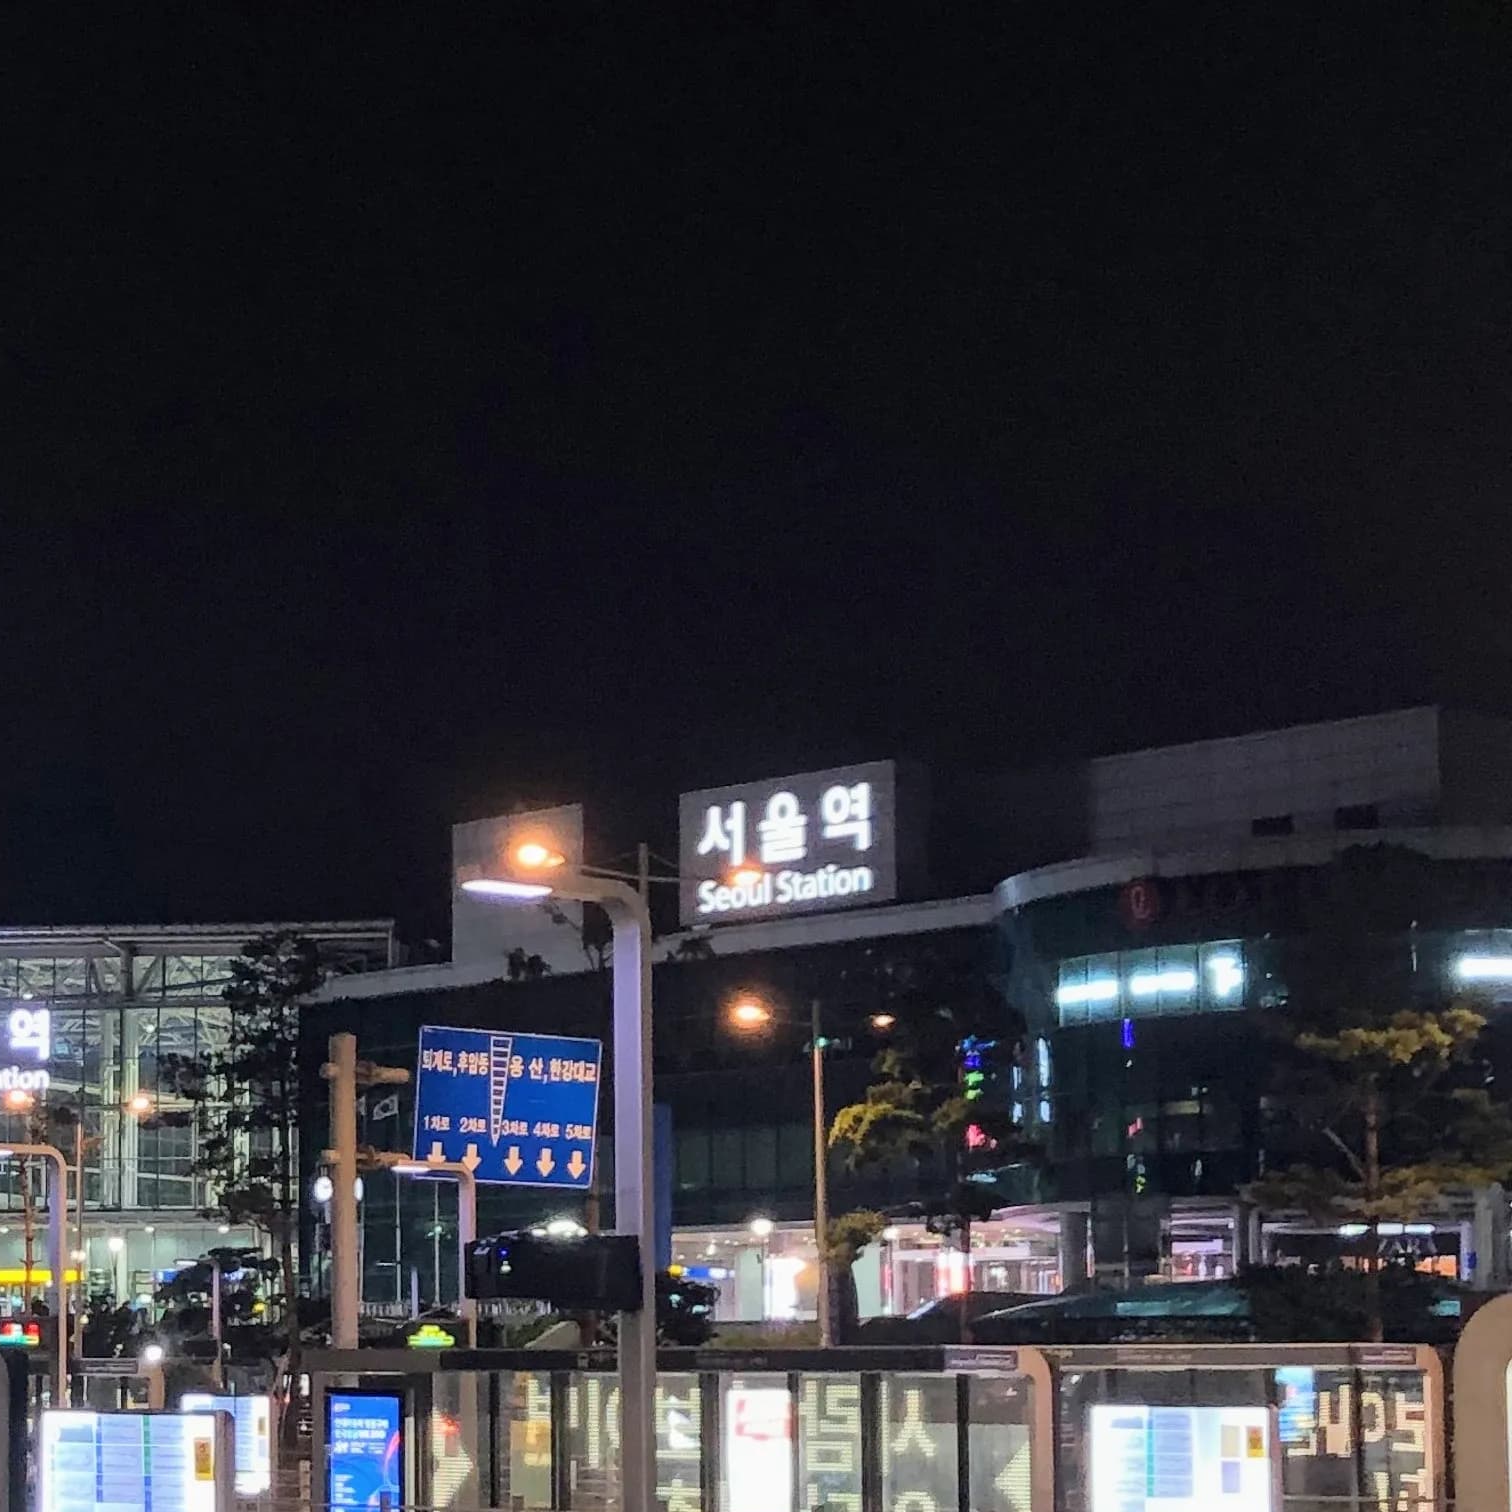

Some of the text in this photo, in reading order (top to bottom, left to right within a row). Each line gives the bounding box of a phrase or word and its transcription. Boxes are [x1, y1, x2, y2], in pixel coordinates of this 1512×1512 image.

[697, 782, 872, 866] 서울역
[698, 863, 873, 913] Seoul Station
